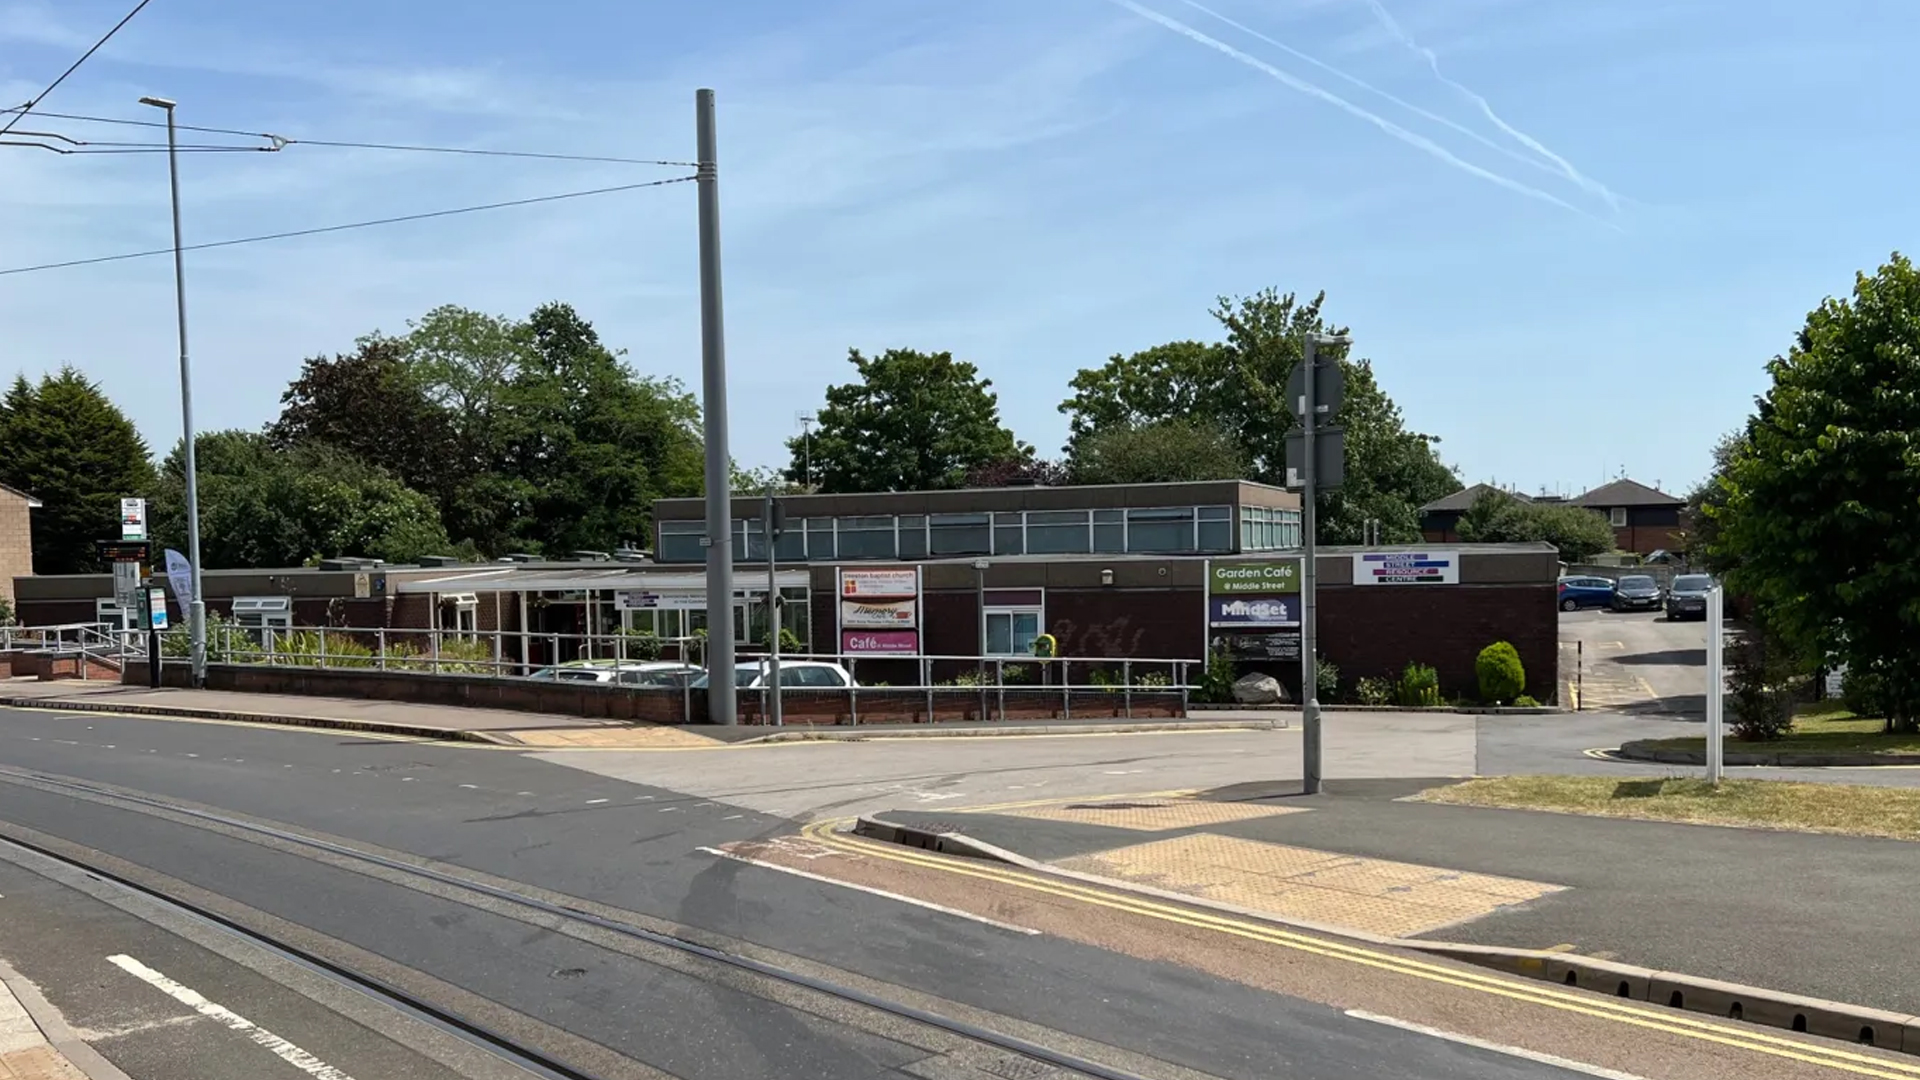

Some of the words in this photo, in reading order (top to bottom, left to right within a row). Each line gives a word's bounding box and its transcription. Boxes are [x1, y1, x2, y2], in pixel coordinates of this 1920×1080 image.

[1216, 568, 1260, 578] Garden
[1264, 566, 1292, 577] Café
[1232, 582, 1260, 590] Middle
[1262, 582, 1285, 590] Street
[850, 637, 877, 648] Café
